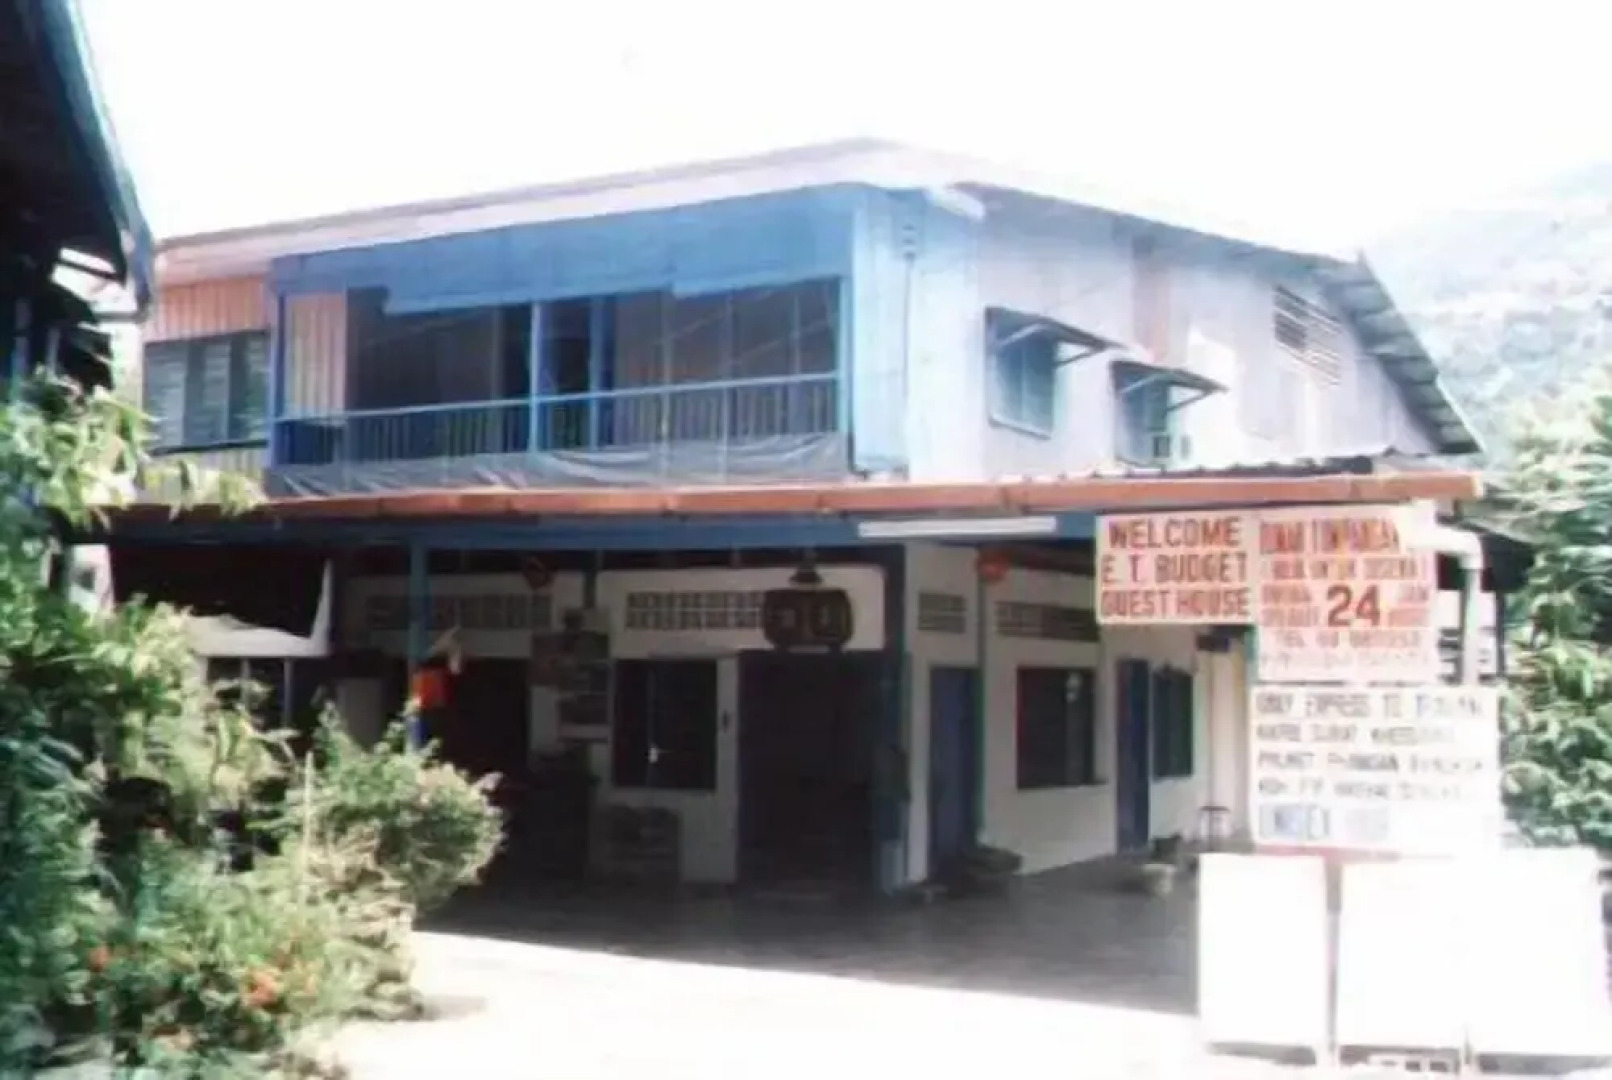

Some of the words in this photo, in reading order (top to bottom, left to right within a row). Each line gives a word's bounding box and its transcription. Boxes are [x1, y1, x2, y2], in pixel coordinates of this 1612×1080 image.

[1108, 516, 1241, 549] WELCOME
[1154, 552, 1247, 583] BUDGET
[1101, 589, 1170, 619] GUEST
[1176, 587, 1250, 617] HOUSE
[1326, 584, 1381, 628] 24
